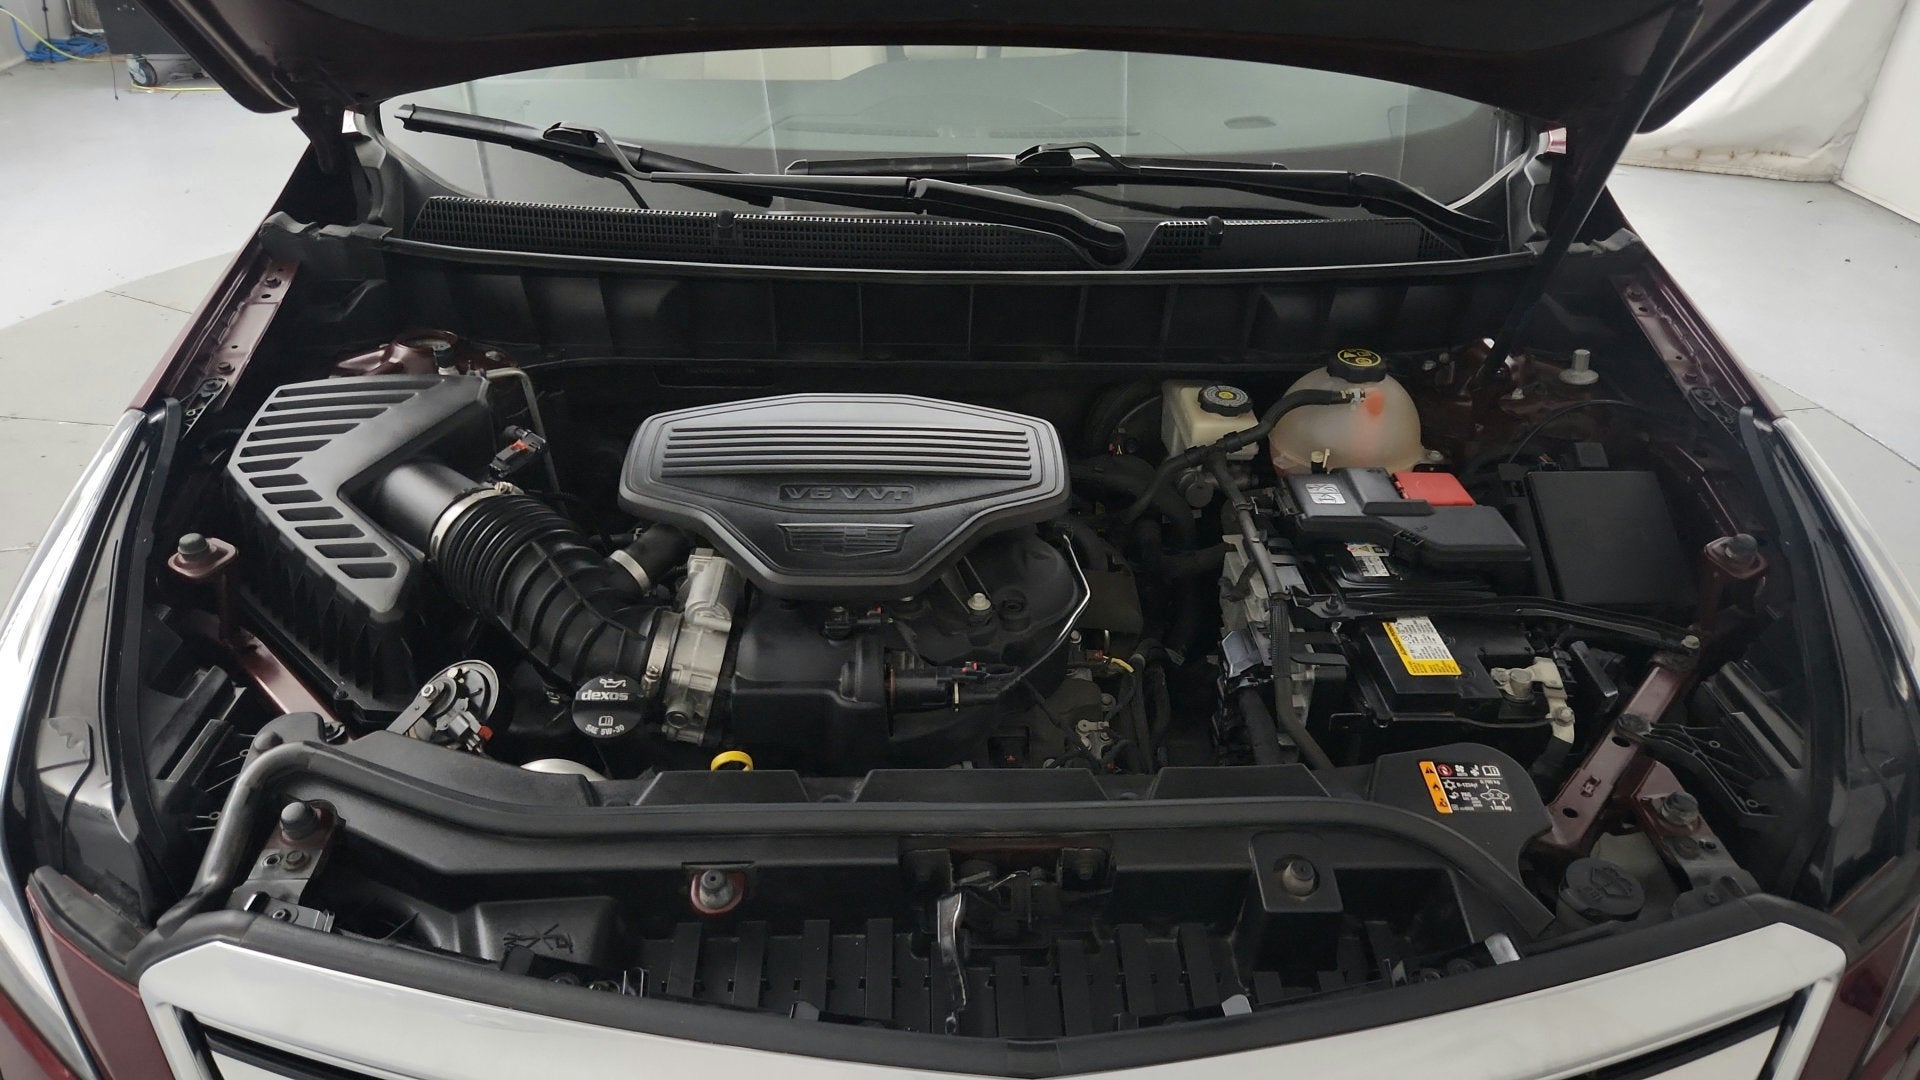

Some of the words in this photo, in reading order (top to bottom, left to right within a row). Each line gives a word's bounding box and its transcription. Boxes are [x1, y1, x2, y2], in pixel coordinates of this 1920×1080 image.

[785, 487, 832, 499] V6
[840, 486, 911, 500] VVT
[581, 689, 630, 700] dexos
[585, 724, 599, 734] SAE
[600, 724, 625, 736] 5W-30
